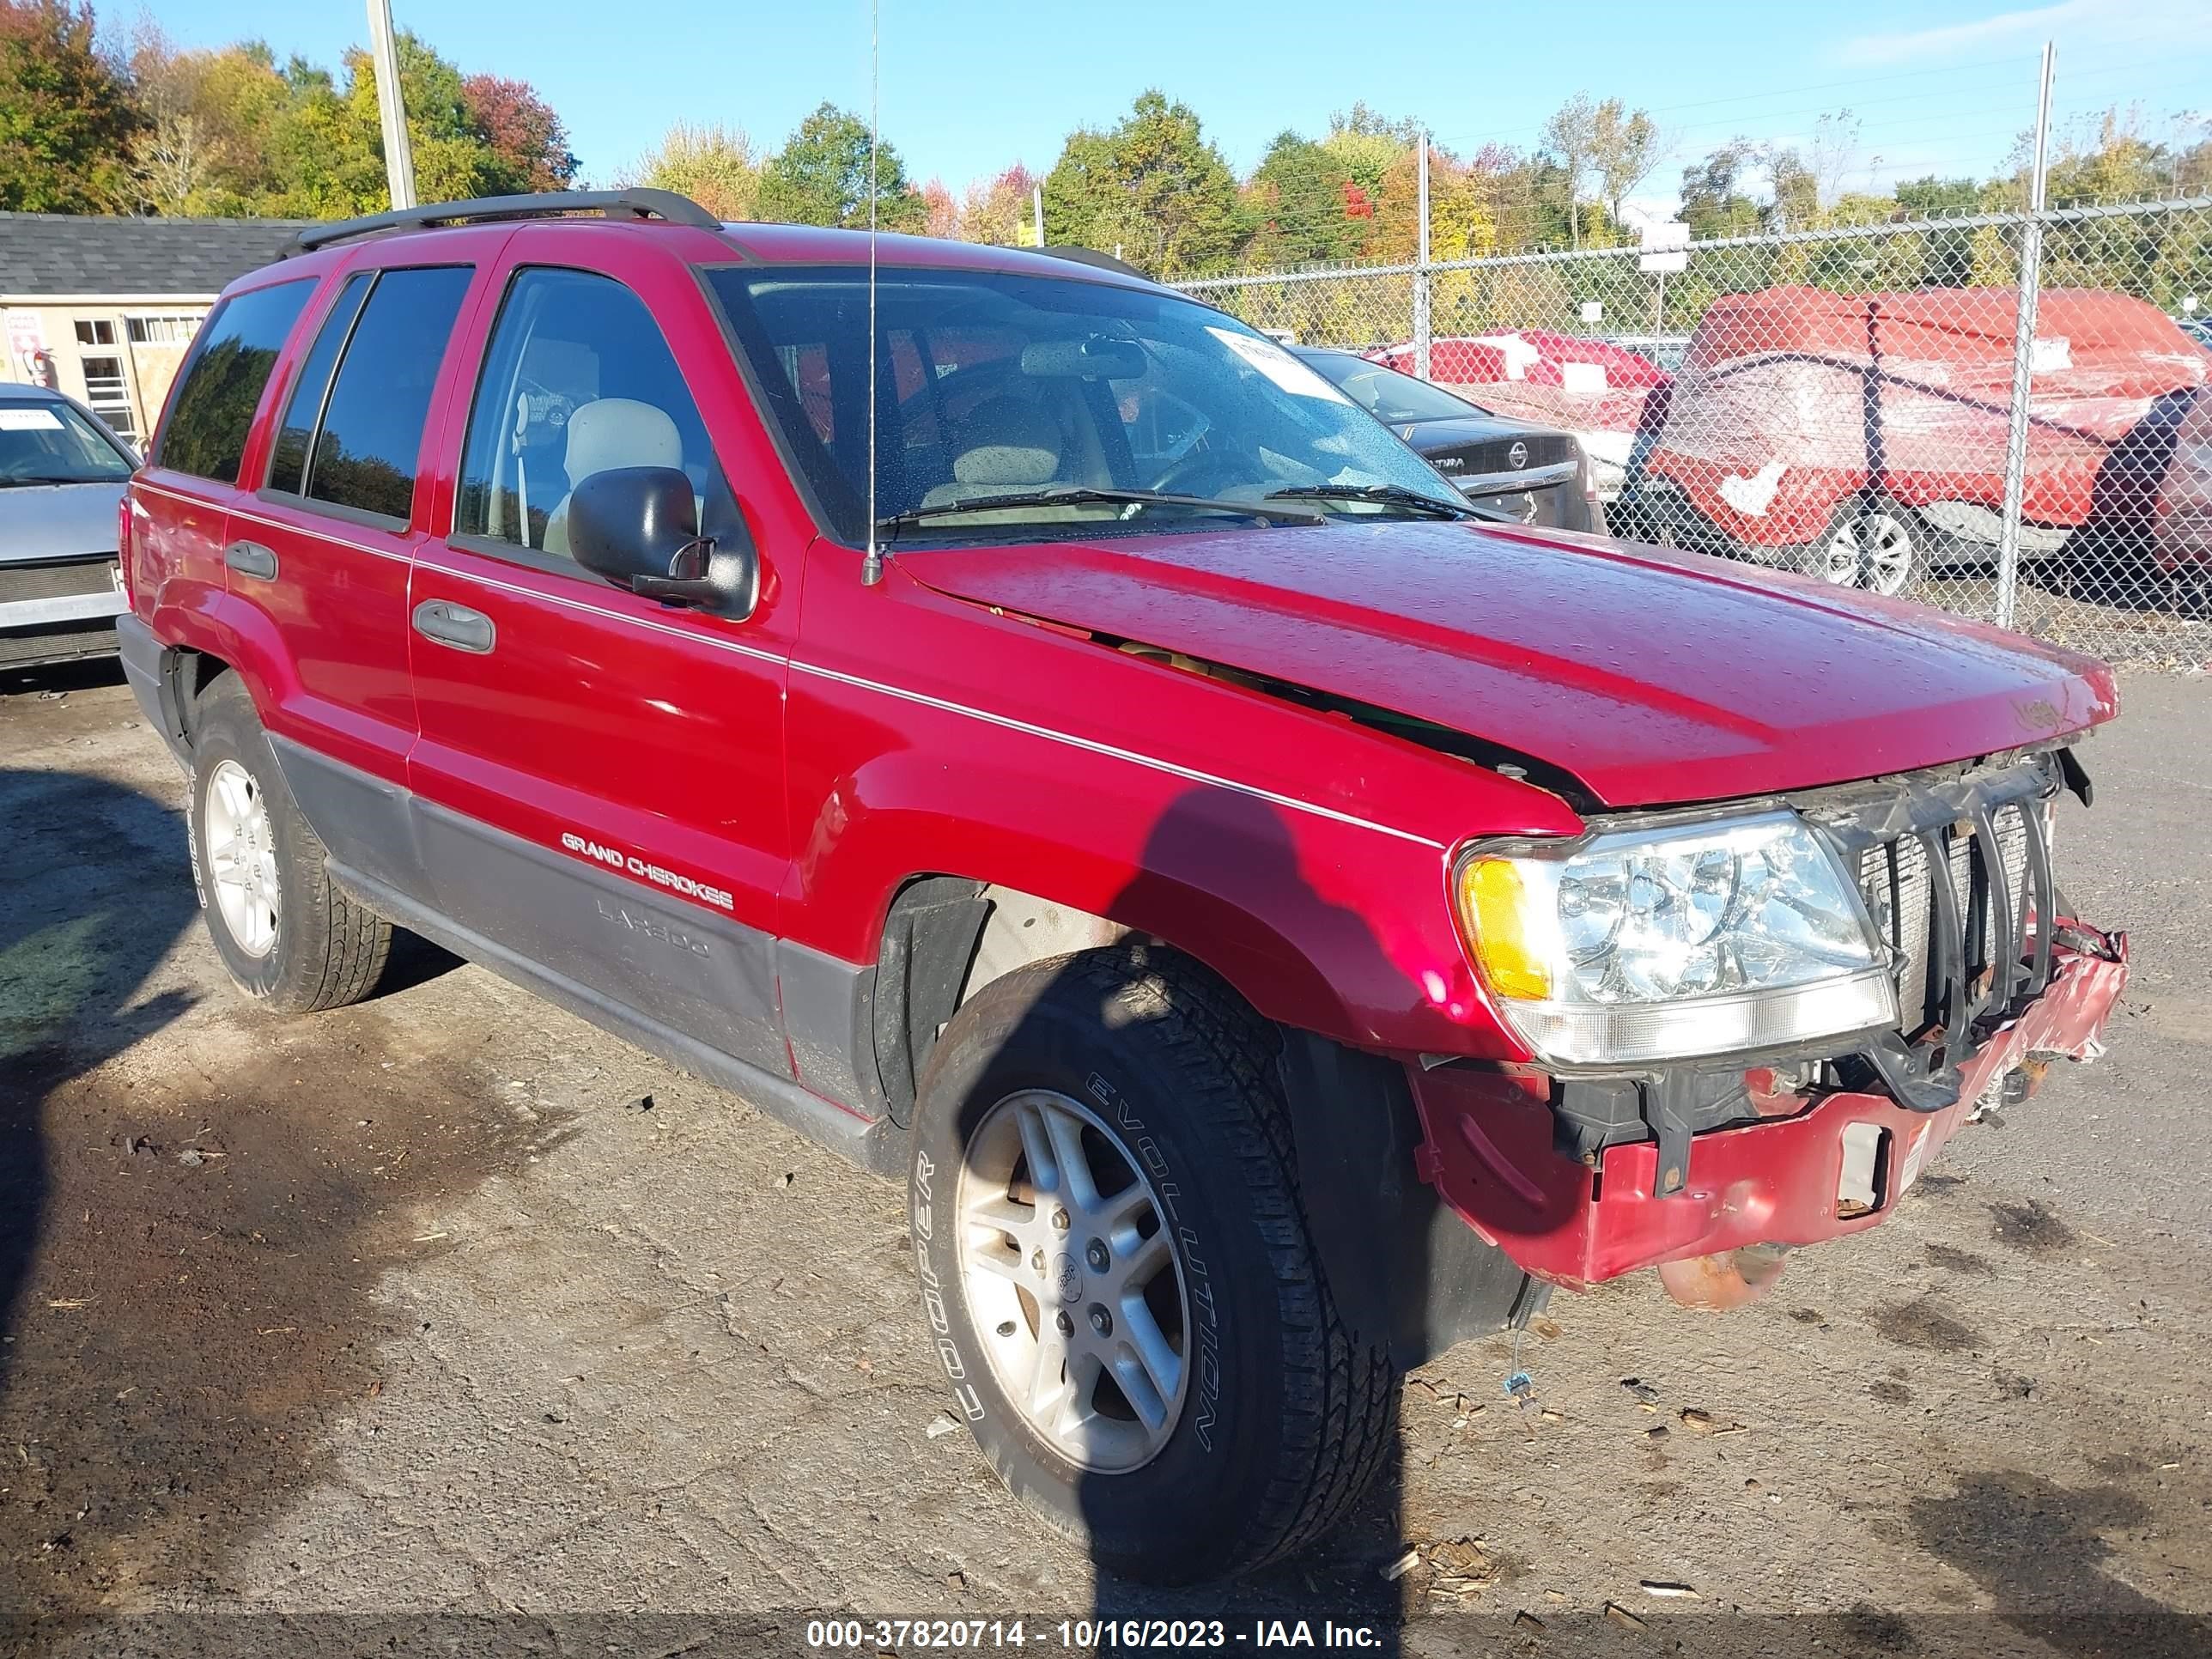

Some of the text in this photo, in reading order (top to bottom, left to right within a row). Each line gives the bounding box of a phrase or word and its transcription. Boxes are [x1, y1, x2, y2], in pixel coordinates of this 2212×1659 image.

[185, 764, 209, 908] COOPER
[562, 832, 734, 910] GRAND CHEROKEE
[597, 899, 710, 958] LAREDO
[915, 1151, 985, 1421] COOPER
[1058, 1264, 1076, 1291] Jeep
[1085, 1071, 1219, 1452] EVOLUTION
